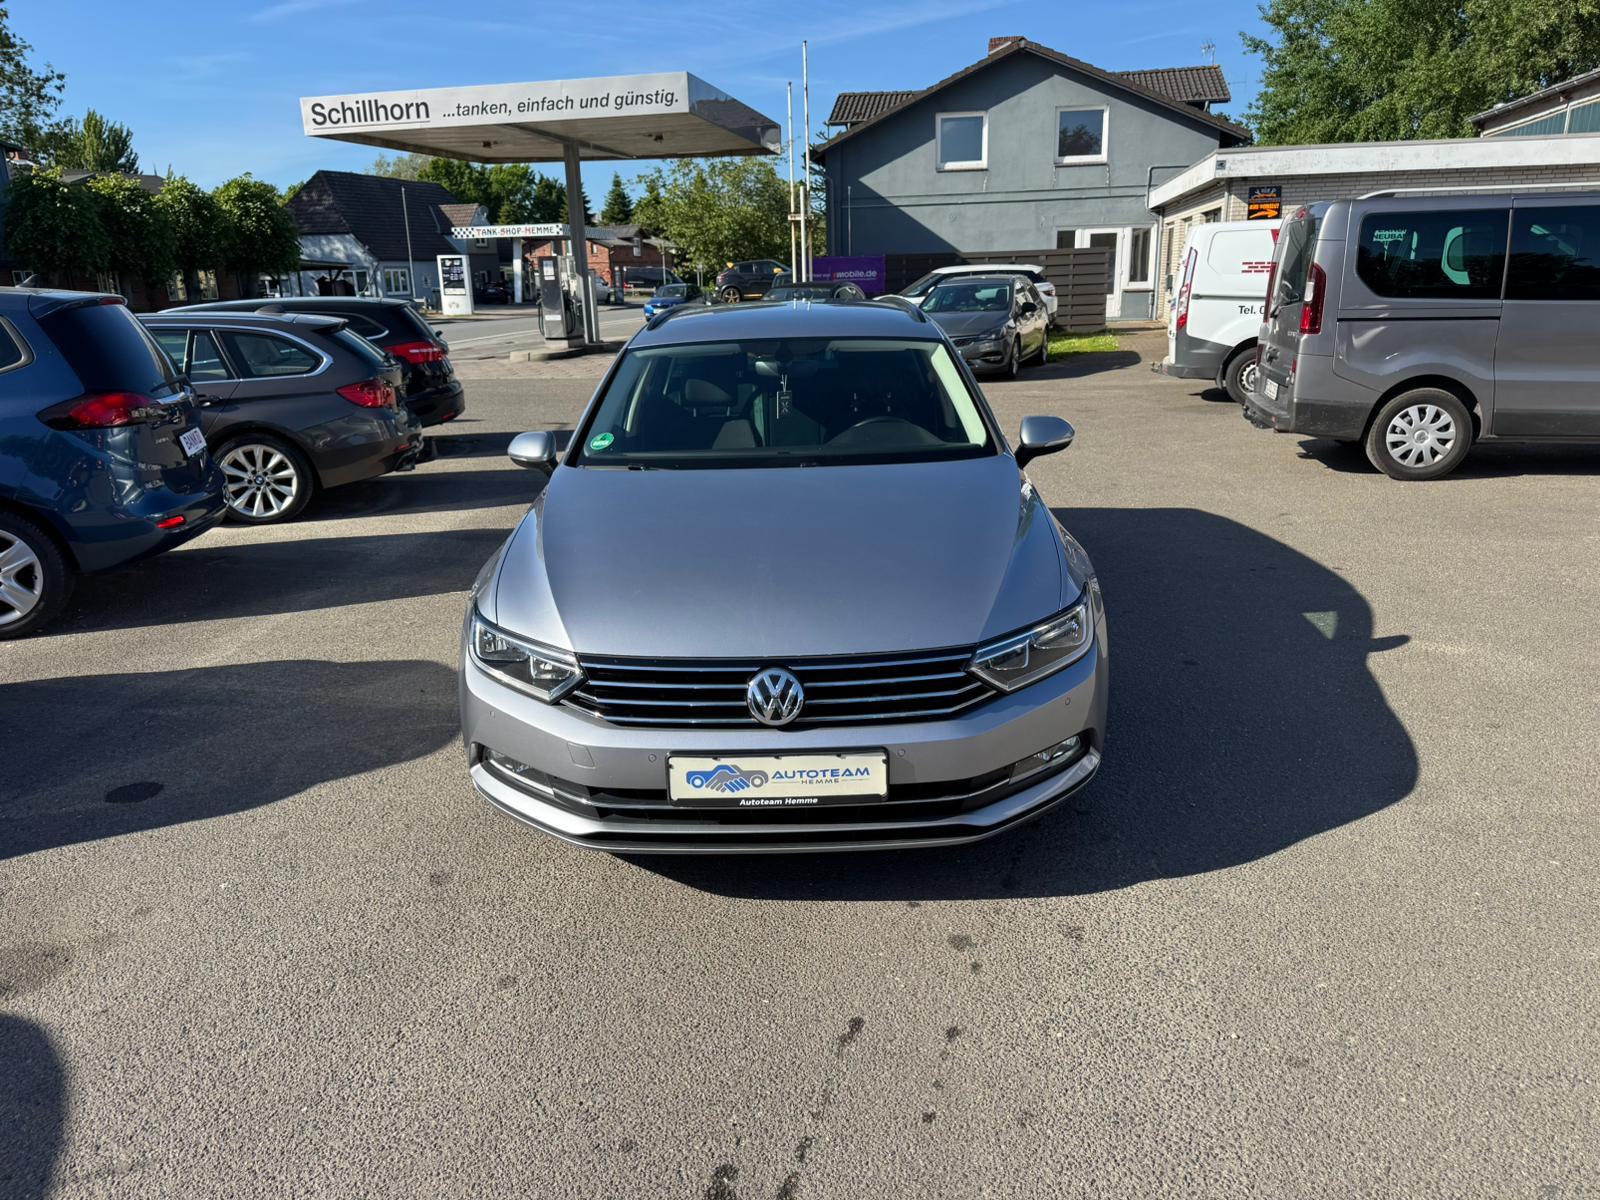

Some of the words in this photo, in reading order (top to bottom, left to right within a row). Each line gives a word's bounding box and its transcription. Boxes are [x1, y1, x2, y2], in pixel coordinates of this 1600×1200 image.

[517, 95, 574, 113] einfach
[580, 92, 610, 109] und
[614, 88, 679, 110] günstig.
[311, 99, 430, 126] Schillhorn
[834, 269, 878, 279] mobile.de
[1238, 305, 1256, 315] Tel.
[771, 767, 871, 779] AUTOTEAM
[739, 798, 783, 806] Autoteam
[784, 797, 819, 805] Hemme
